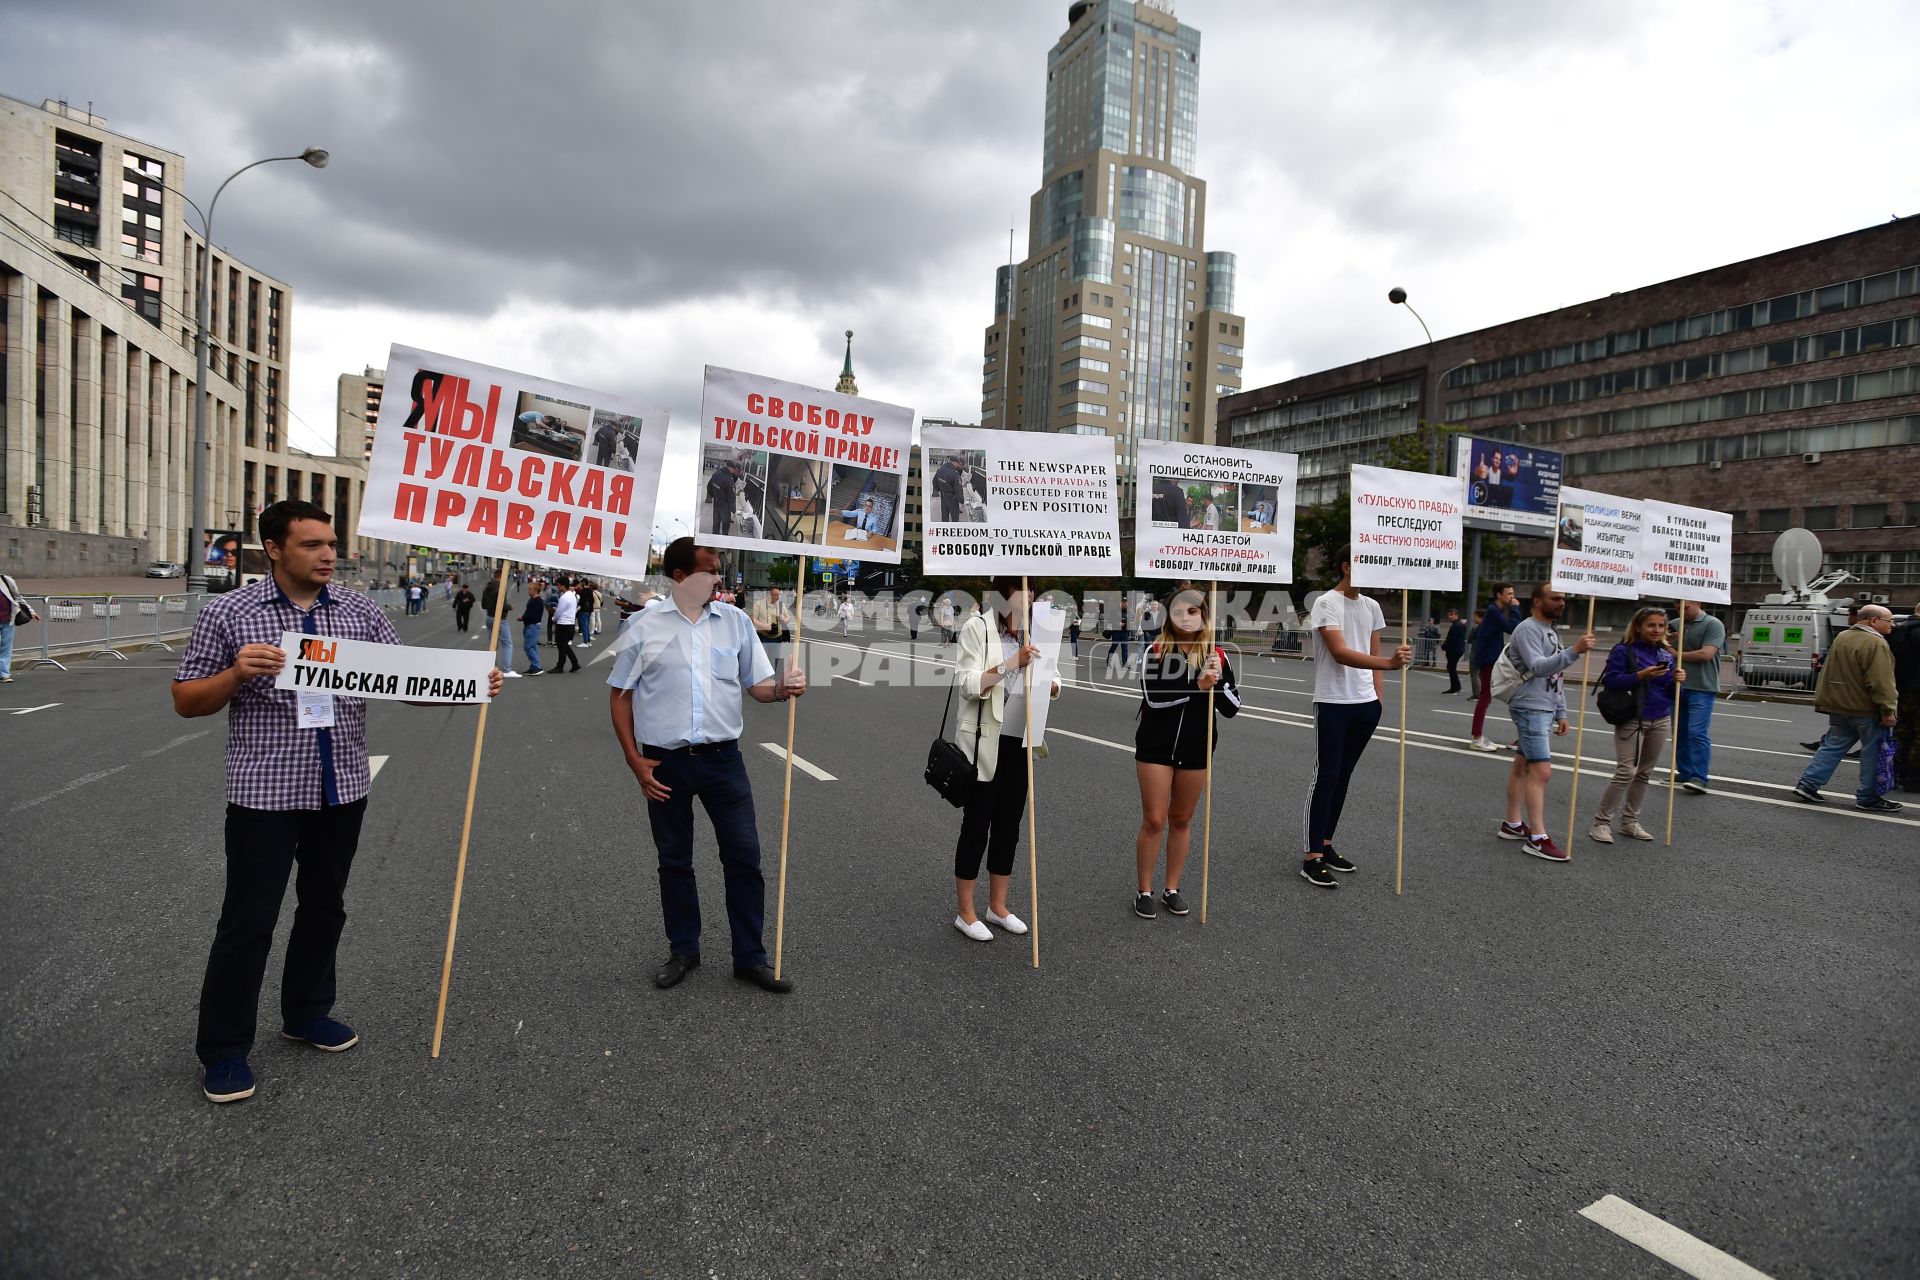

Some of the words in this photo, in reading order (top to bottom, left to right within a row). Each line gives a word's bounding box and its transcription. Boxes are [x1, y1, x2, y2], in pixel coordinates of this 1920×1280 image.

[747, 393, 874, 437] СВОБОДУ
[714, 416, 820, 455] ТУЛЬСКОЙ
[824, 436, 899, 470] ПРАВДЕ!
[998, 460, 1025, 472] THE
[1029, 462, 1106, 476] NEWSPAPER
[1184, 454, 1252, 468] ОСТАНОВИТЬ
[403, 432, 634, 516] ТУЛЬСКАЯ
[988, 474, 1046, 486] «TULSKAYA
[1050, 477, 1096, 487] PRAVDA»
[1098, 479, 1108, 488] IS
[1149, 465, 1230, 480] ПОЛИЦЕЙСКУЮ
[1232, 472, 1284, 485] РАСПРАВУ
[991, 486, 1061, 498] PROSECUTED
[1064, 489, 1084, 498] FOR
[1088, 490, 1108, 500] THE
[1003, 500, 1038, 512] OPEN
[1042, 502, 1108, 514] POSITION!
[1358, 494, 1416, 510] «ТУЛЬСКУЮ
[1418, 500, 1458, 515] ПРАВДУ»
[394, 482, 628, 557] ПРАВДА!
[1378, 515, 1442, 532] ПРЕСЛЕДУЮТ
[1622, 510, 1642, 522] ВЕРНИ
[1674, 517, 1706, 529] ТУЛЬСКОЙ
[1584, 518, 1612, 528] РЕДАКЦИИ
[1612, 522, 1640, 533] НЕЗАКОННО
[928, 528, 1112, 540] #FREEDOM_TO_TULSKAYA_PRAVDA
[1182, 533, 1204, 544] НАД
[1206, 534, 1250, 546] ГАЗЕТОЙ
[1359, 533, 1370, 544] ЗА
[1372, 534, 1412, 547] ЧЕСТНУЮ
[1414, 537, 1457, 550] ПОЗИЦИЮ!
[1596, 532, 1626, 544] ИЗЪЯТЫЕ
[1652, 525, 1682, 537] ОБЛАСТИ
[1685, 531, 1720, 543] СИЛОВЫМИ
[932, 543, 1112, 558] #СВОБОДУ_ТУЛЬСКОЙ_ПРАВДЕ
[1159, 545, 1218, 557] «ТУЛЬСКАЯ
[1584, 544, 1611, 556] ТИРАЖИ
[1612, 548, 1634, 560] ГАЗЕТЫ
[1670, 540, 1705, 552] МЕТОДАМИ
[1354, 554, 1460, 570] #СВОБОДУ_ТУЛЬСКОЙ_ПРАВДЕ
[1561, 558, 1599, 570] «ТУЛЬСКАЯ
[1664, 552, 1708, 564] УЩЕМЛЯЕТСЯ
[1149, 559, 1276, 574] #СВОБОДУ_ТУЛЬСКОЙ_ПРАВДЕ
[1654, 562, 1687, 575] СВОБОДА
[1691, 568, 1713, 578] СЛОВА
[1748, 614, 1811, 622] TELEVISION
[294, 665, 398, 695] ТУЛЬСКАЯ
[405, 676, 476, 701] ПРАВДА
